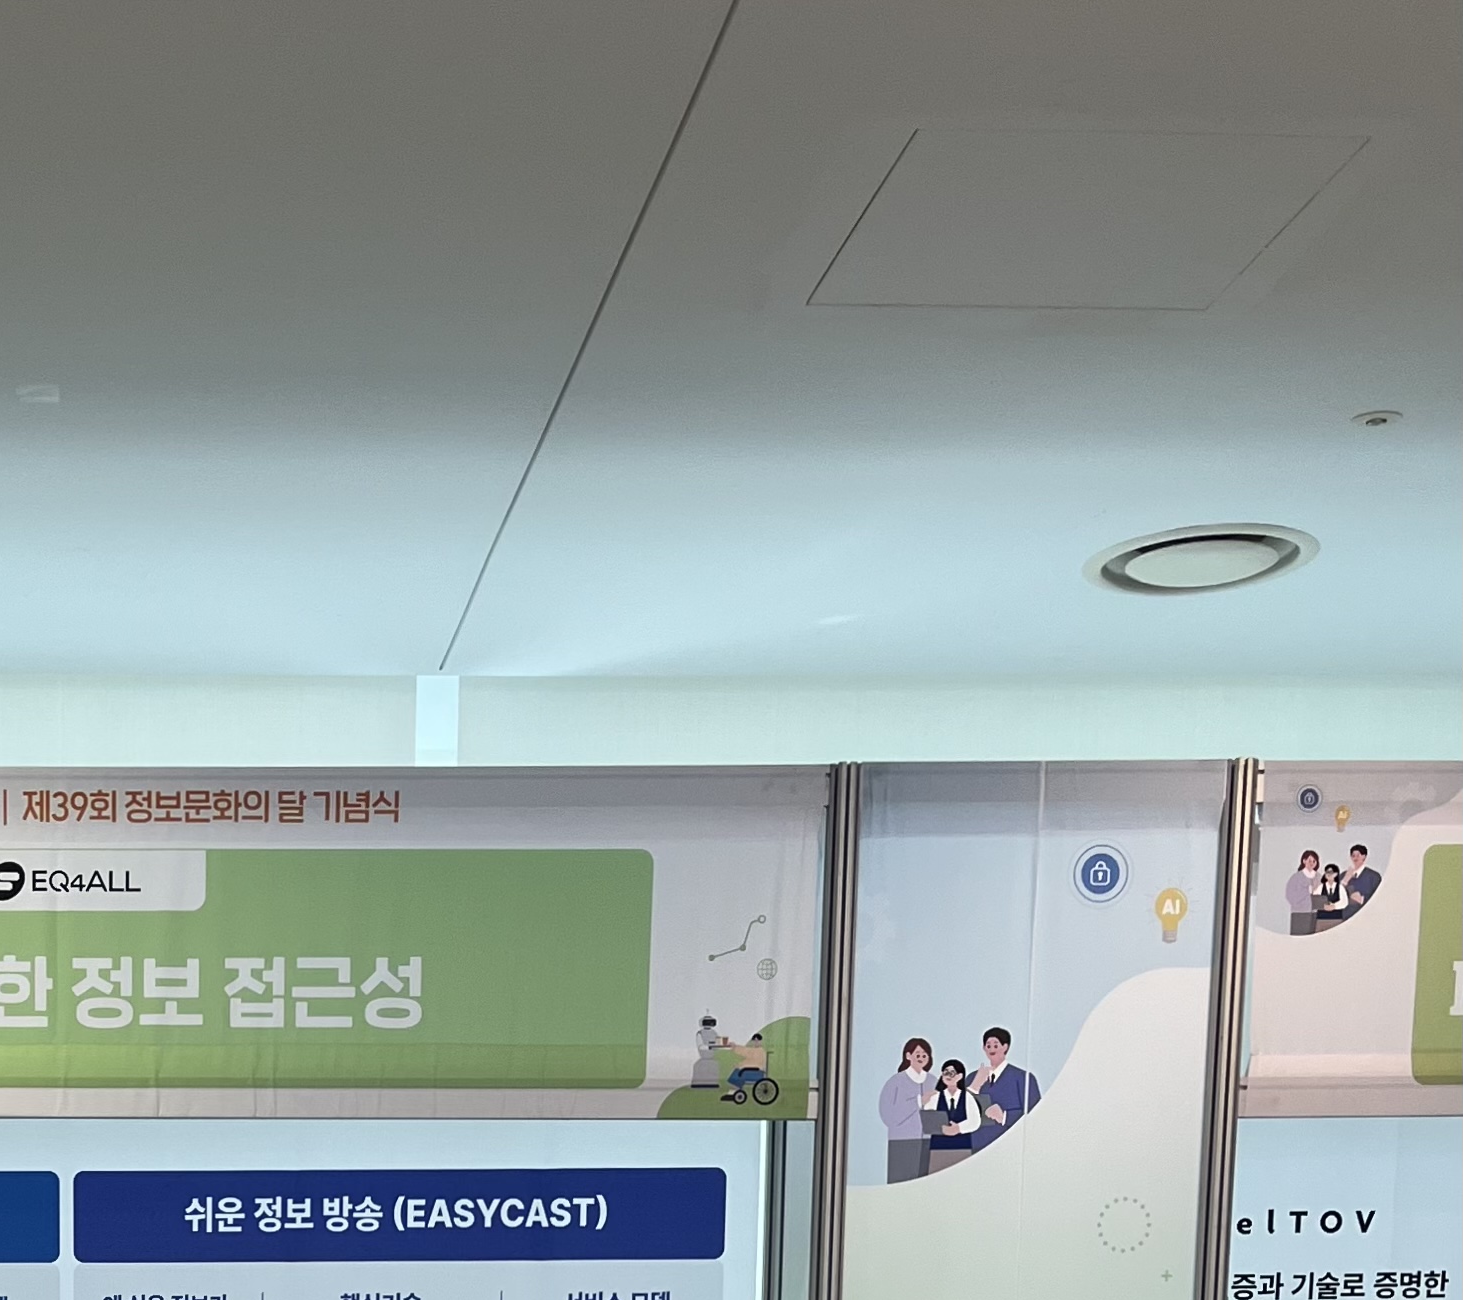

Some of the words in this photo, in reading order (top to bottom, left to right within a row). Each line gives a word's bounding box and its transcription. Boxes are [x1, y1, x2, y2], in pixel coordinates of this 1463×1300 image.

[23, 790, 116, 822] 제39회
[125, 790, 269, 823] 정보문화의
[278, 790, 307, 823] 달
[313, 790, 399, 823] 기념식
[31, 869, 142, 894] EQ4ALL
[72, 957, 203, 1028] 정보
[223, 956, 424, 1029] 접근성
[185, 1197, 245, 1232] 쉬운
[254, 1196, 314, 1232] 정보
[323, 1196, 383, 1232] 방송
[394, 1195, 607, 1231] (EASYCAST)
